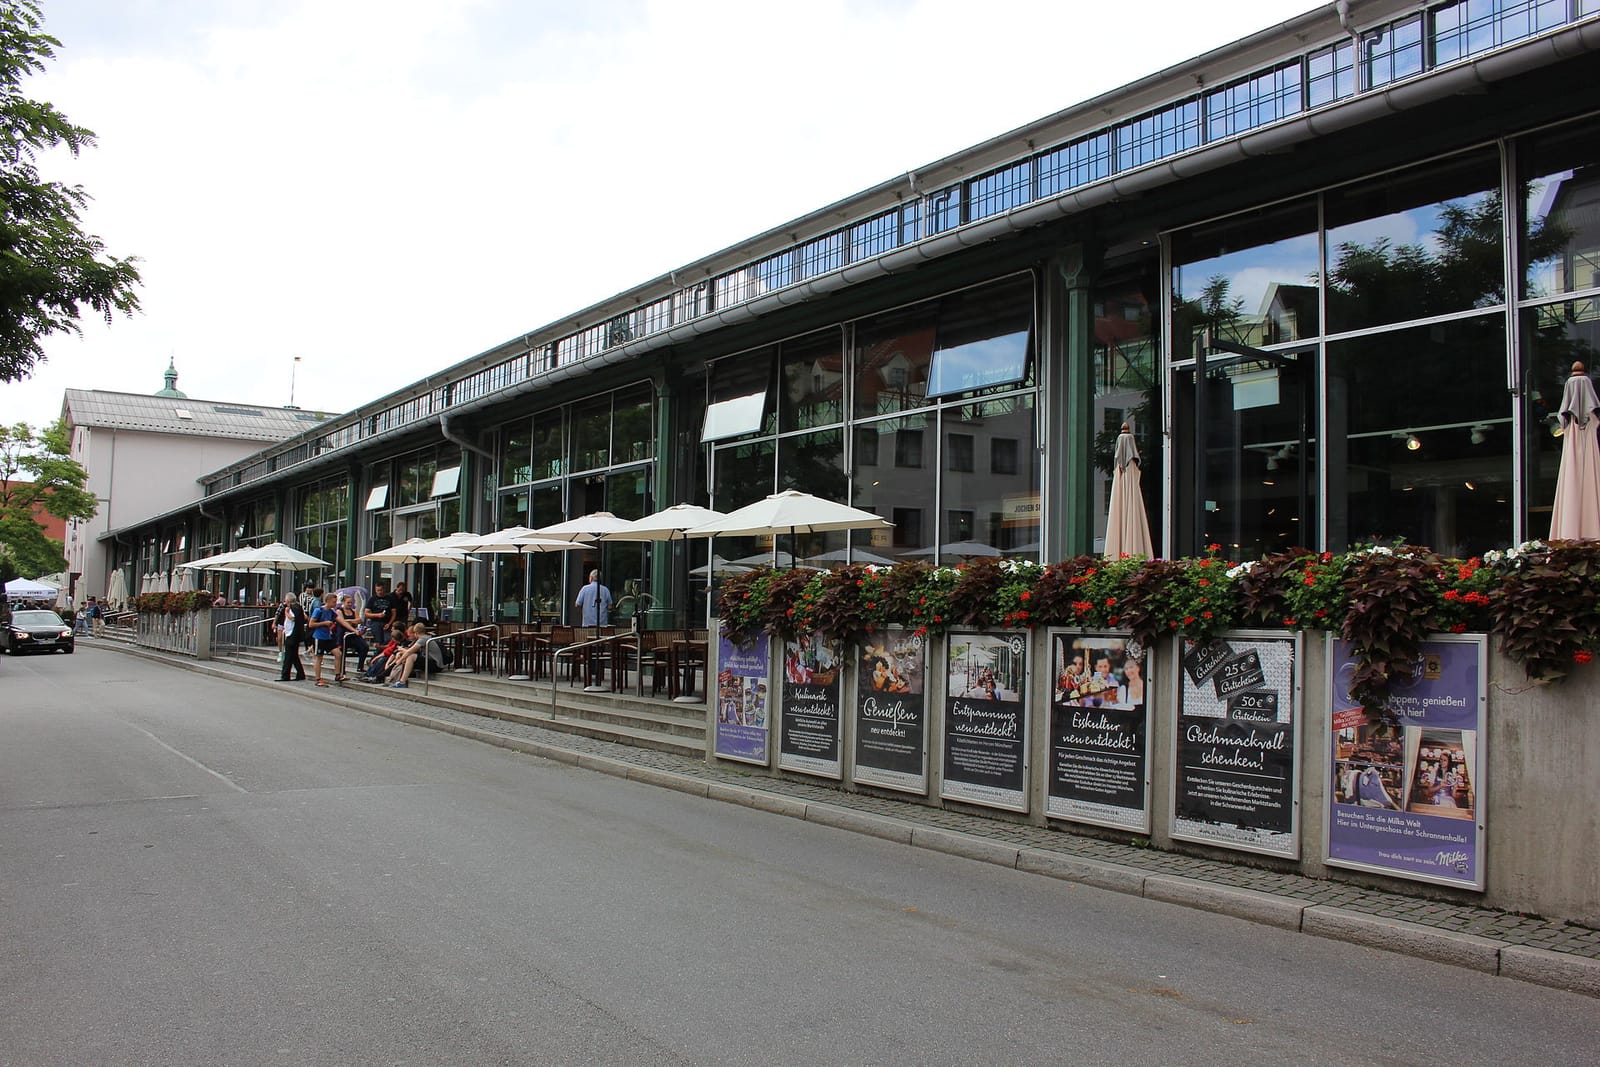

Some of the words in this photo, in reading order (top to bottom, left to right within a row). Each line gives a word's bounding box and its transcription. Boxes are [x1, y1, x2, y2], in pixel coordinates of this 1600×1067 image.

[1014, 504, 1034, 512] JOCHEN
[1196, 645, 1208, 662] 10
[1196, 650, 1227, 679] Gutschein
[1224, 663, 1239, 677] 25
[1240, 662, 1247, 671] €
[1221, 675, 1258, 693] Gutschein
[1241, 696, 1255, 707] 50
[1256, 698, 1264, 707] €
[1422, 695, 1466, 707] genießen!
[863, 697, 917, 730] Genießen
[953, 700, 1016, 727] Entspannung
[1072, 711, 1121, 731] Esskultur
[1232, 709, 1271, 722] Gutschein
[1407, 708, 1425, 718] hier!
[881, 729, 905, 738] entdeckt!
[955, 724, 973, 732] neu
[974, 722, 1017, 739] entdeckt!
[1187, 725, 1284, 750] Geschmackvoll
[1062, 734, 1084, 743] neu
[1085, 732, 1136, 751] entdeckt!
[1202, 747, 1264, 770] schenken!
[1337, 810, 1365, 820] Besuchen
[1376, 815, 1386, 823] die
[1387, 817, 1405, 826] Milka
[1406, 819, 1421, 828] Welt
[1337, 818, 1350, 827] Hier
[1351, 820, 1358, 828] im
[1359, 821, 1402, 834] Untergeschoss
[1403, 828, 1414, 836] der
[1415, 830, 1467, 843] Schrannenhalle!
[1435, 851, 1469, 866] Milka
